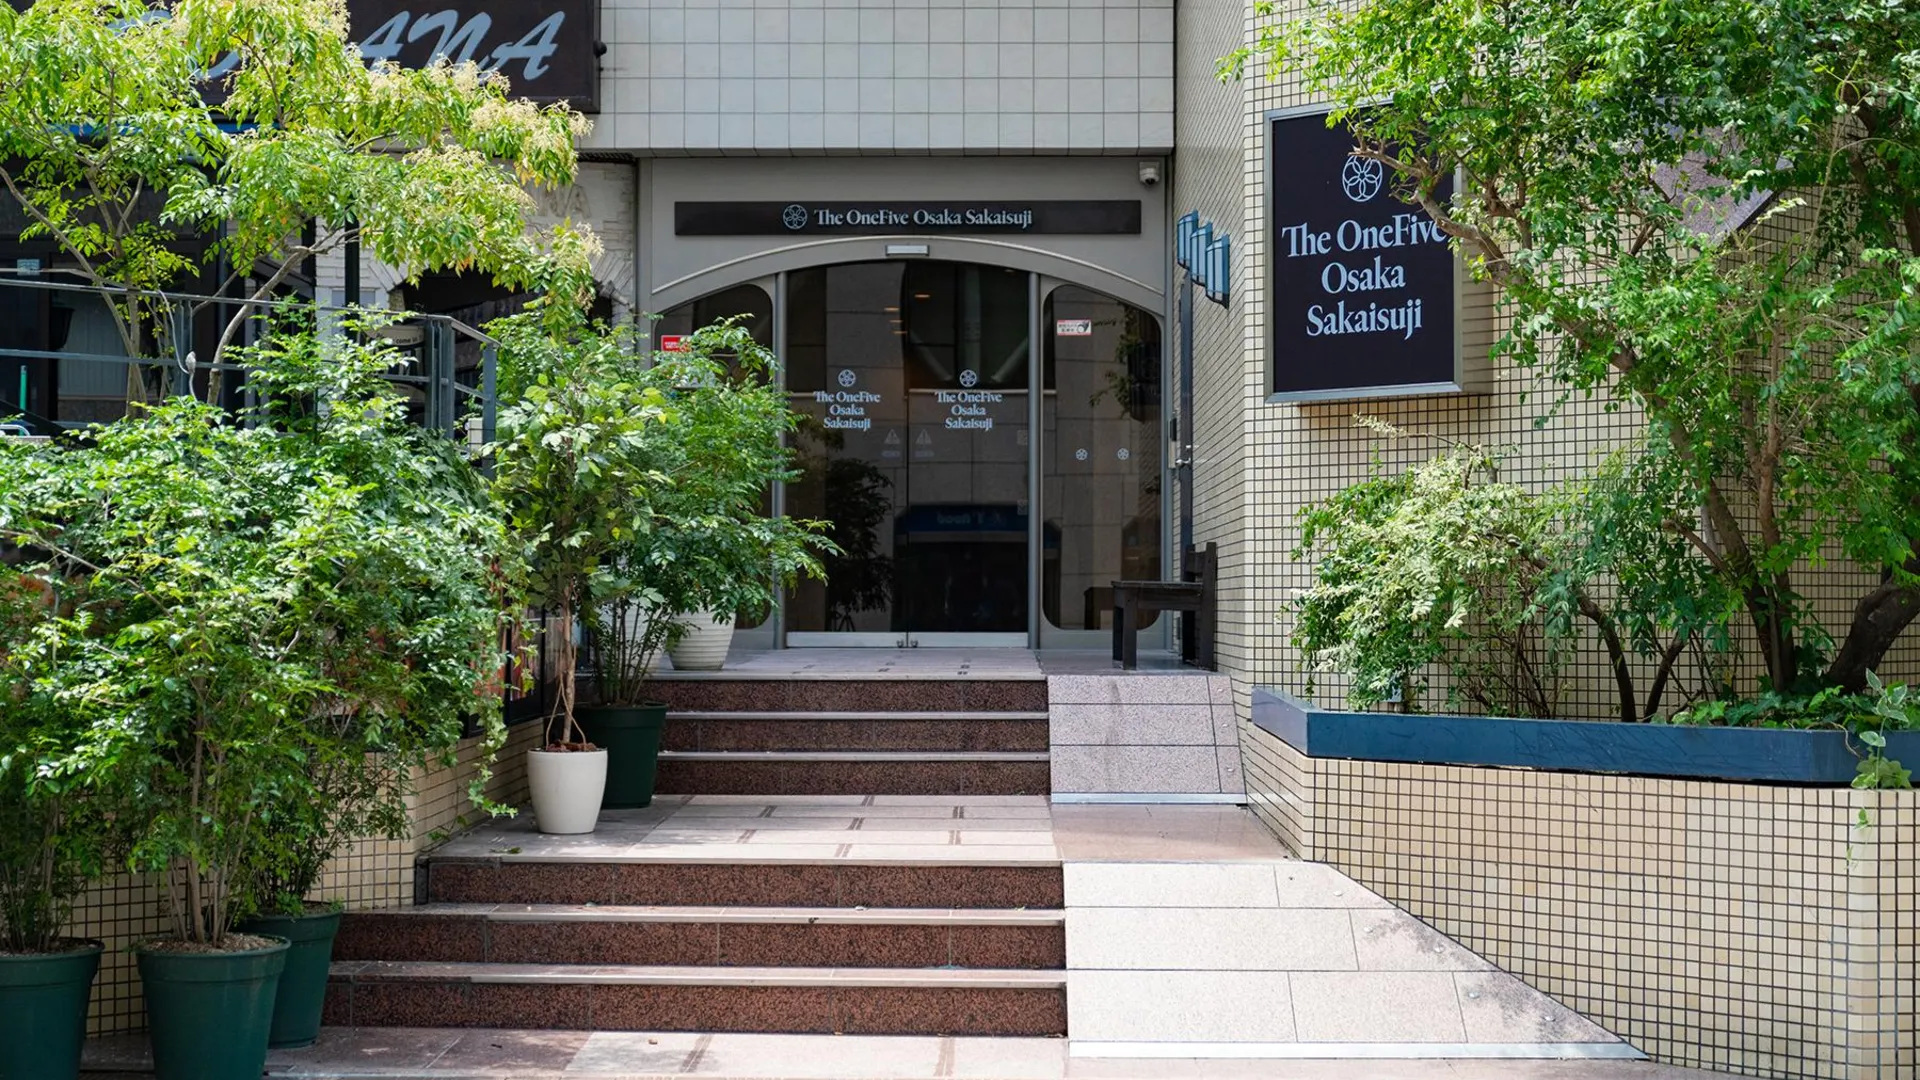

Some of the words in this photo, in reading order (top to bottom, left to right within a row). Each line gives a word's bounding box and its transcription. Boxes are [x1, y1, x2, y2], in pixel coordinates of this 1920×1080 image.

[813, 208, 843, 225] The
[846, 208, 909, 225] OneFive
[913, 208, 962, 225] Osaka
[965, 208, 1033, 229] Sakaisuji
[1281, 222, 1332, 258] The
[1321, 255, 1406, 294] Osaka
[1306, 298, 1423, 340] Sakaisuji
[813, 391, 835, 403] The
[836, 391, 881, 403] OneFive
[935, 391, 957, 403] The
[957, 391, 1002, 403] OneFive
[829, 404, 865, 416] Osaka
[951, 404, 987, 416] Osaka
[823, 417, 871, 431] Sakaisuji
[945, 417, 993, 431] Sakaisuji
